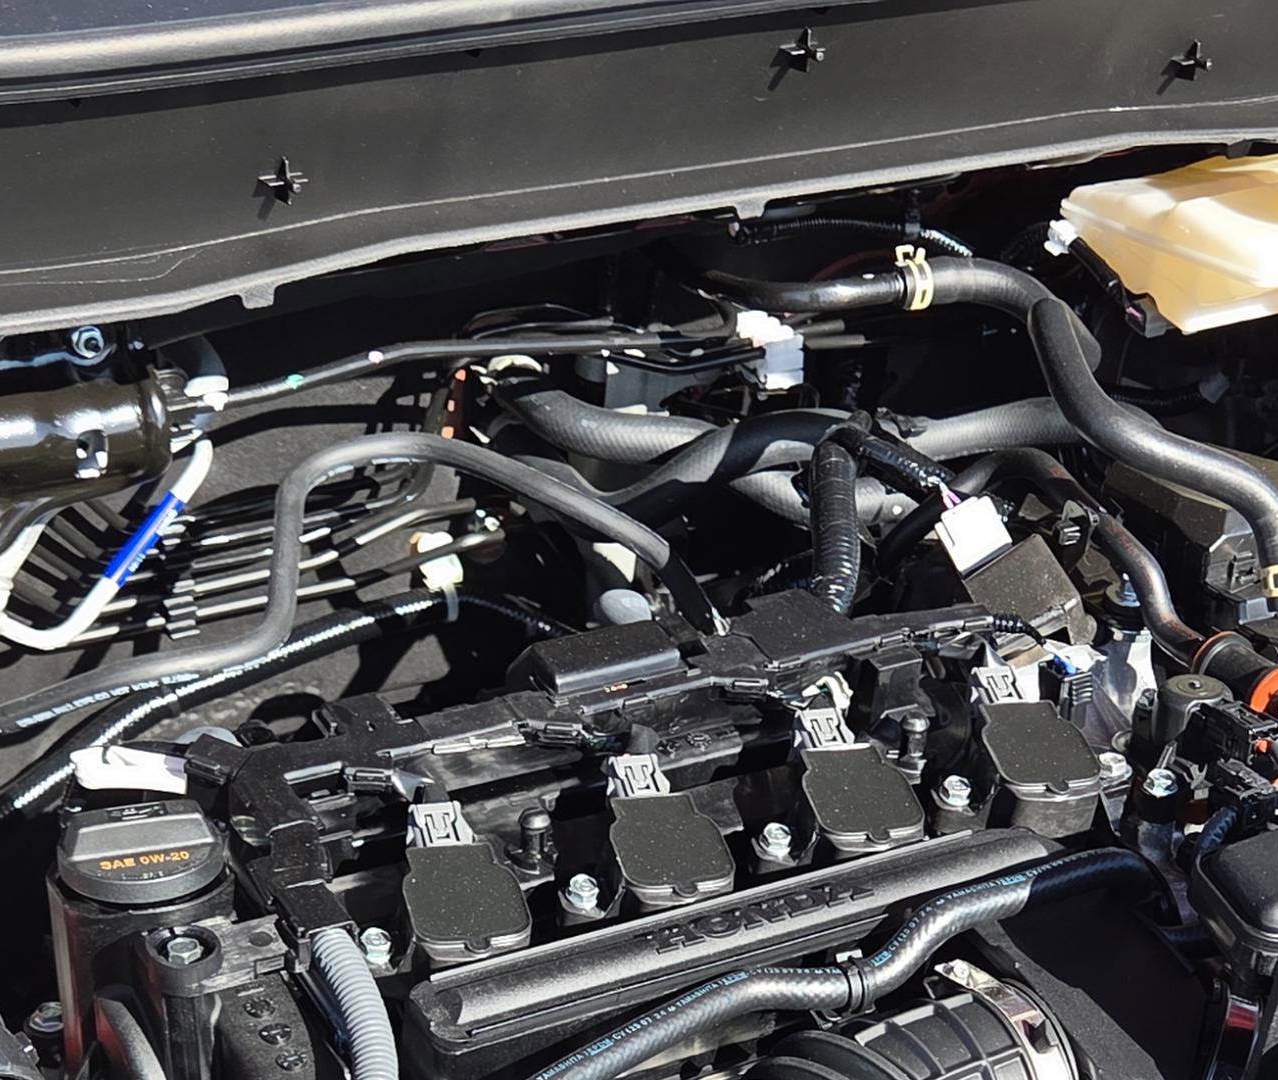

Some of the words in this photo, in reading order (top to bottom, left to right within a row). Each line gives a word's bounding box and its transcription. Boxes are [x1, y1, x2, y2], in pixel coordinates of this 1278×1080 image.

[99, 857, 136, 871] SAE
[139, 850, 190, 865] 0W-20
[635, 883, 876, 955] HONDA
